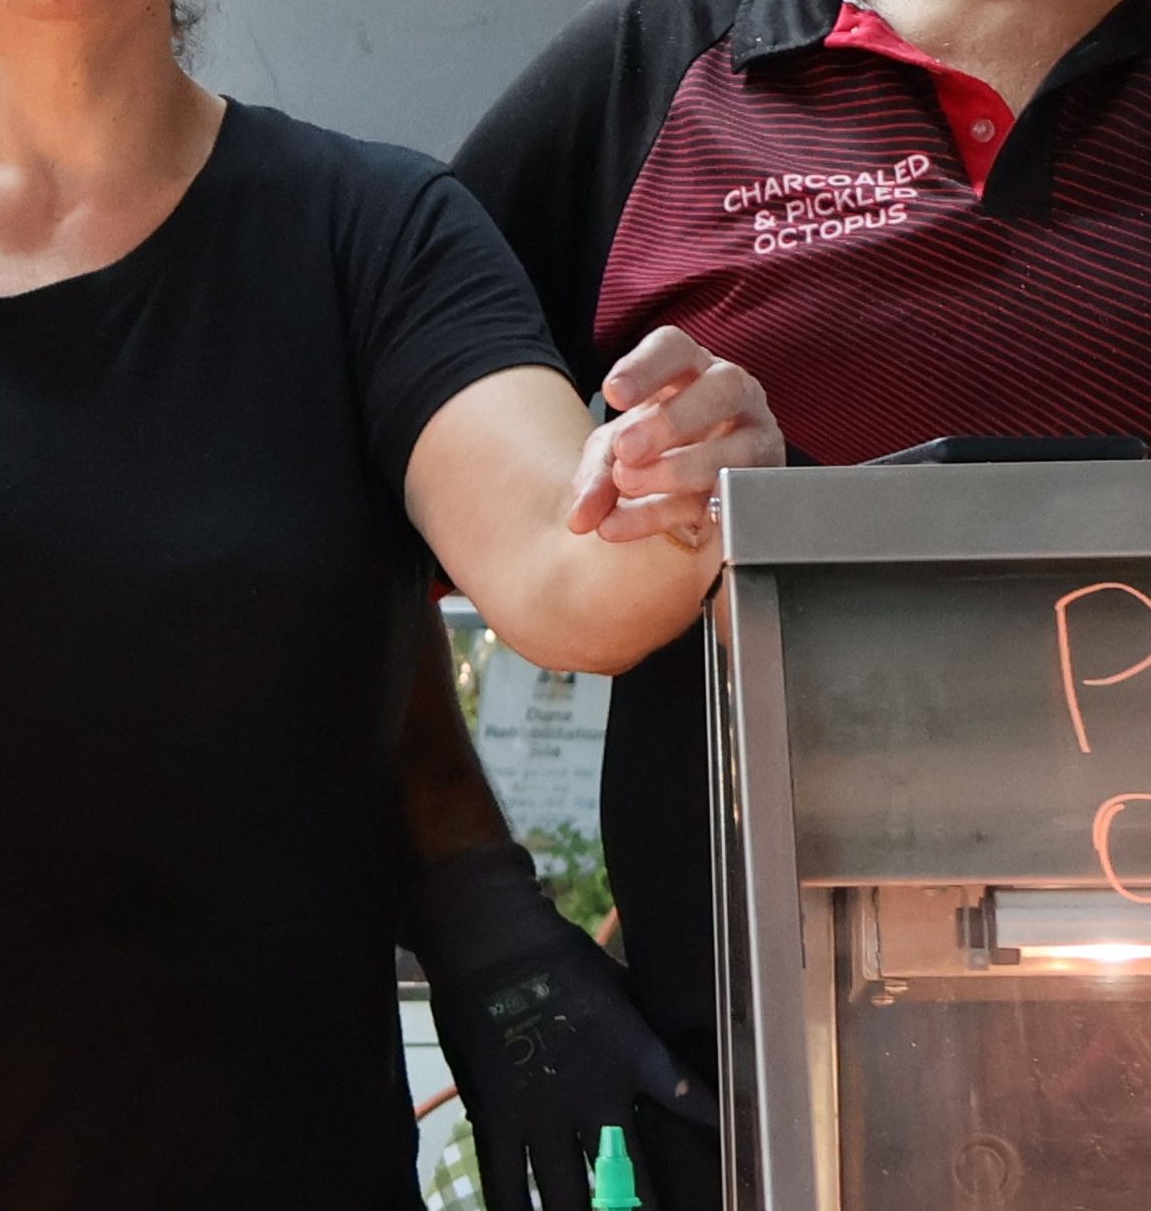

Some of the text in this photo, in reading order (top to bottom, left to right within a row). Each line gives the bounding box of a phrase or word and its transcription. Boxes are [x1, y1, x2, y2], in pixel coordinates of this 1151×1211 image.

[723, 154, 930, 213] CHARCOALED
[753, 187, 919, 231] & PICKLED
[753, 203, 908, 255] OCTOPUS
